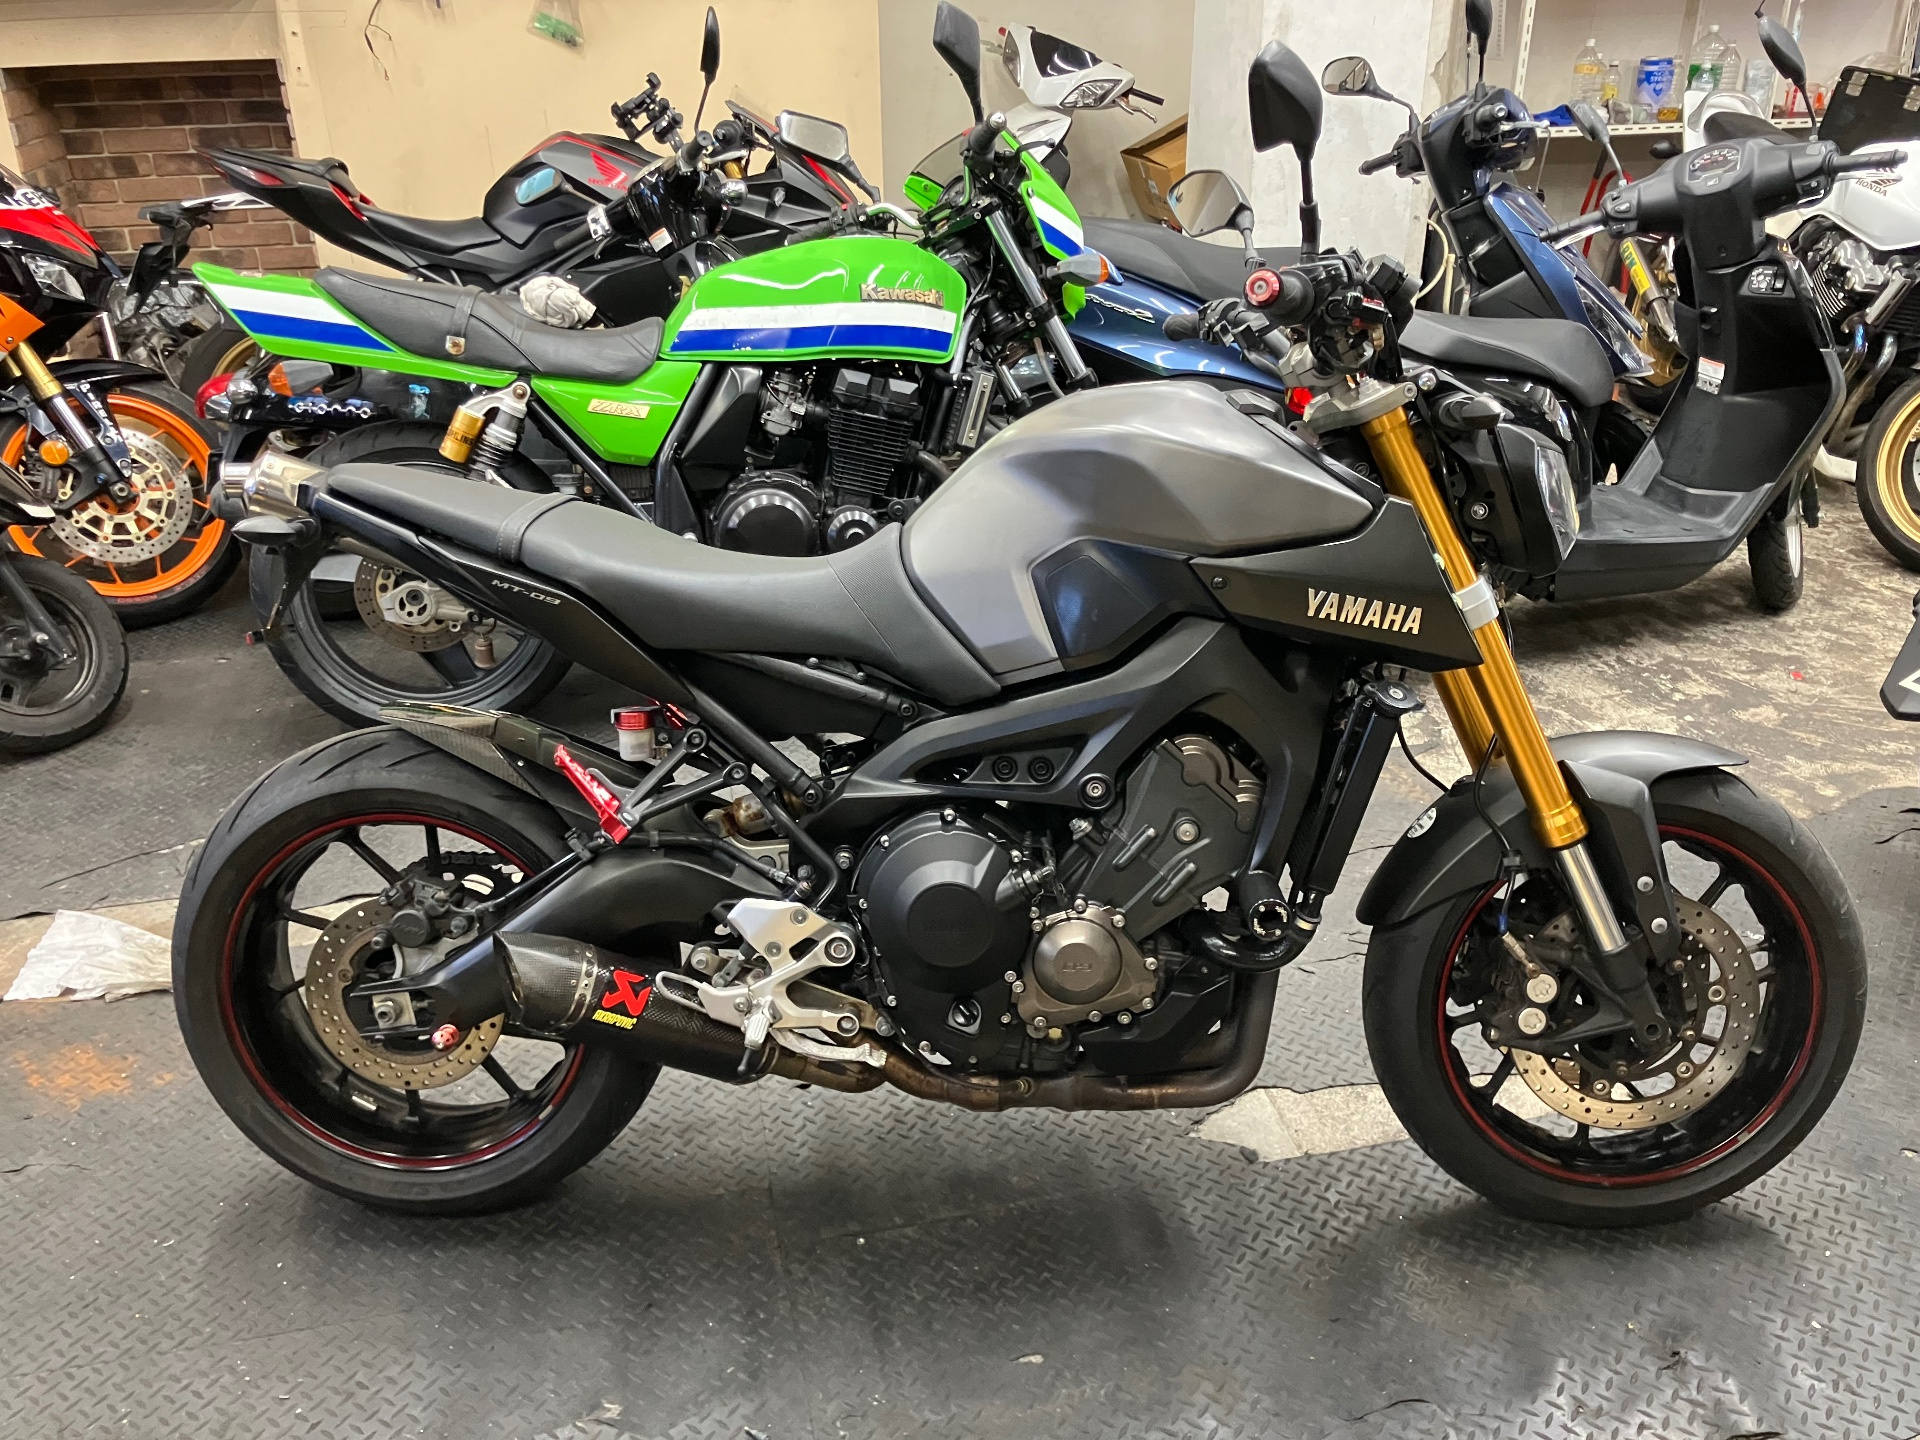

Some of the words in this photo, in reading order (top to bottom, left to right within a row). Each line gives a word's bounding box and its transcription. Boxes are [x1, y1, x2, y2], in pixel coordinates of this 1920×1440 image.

[1855, 178, 1888, 197] HONDA
[860, 283, 943, 308] Kawasaki
[591, 401, 646, 417] ZRX
[491, 579, 561, 605] MT-09
[1307, 588, 1423, 635] YAMAHA
